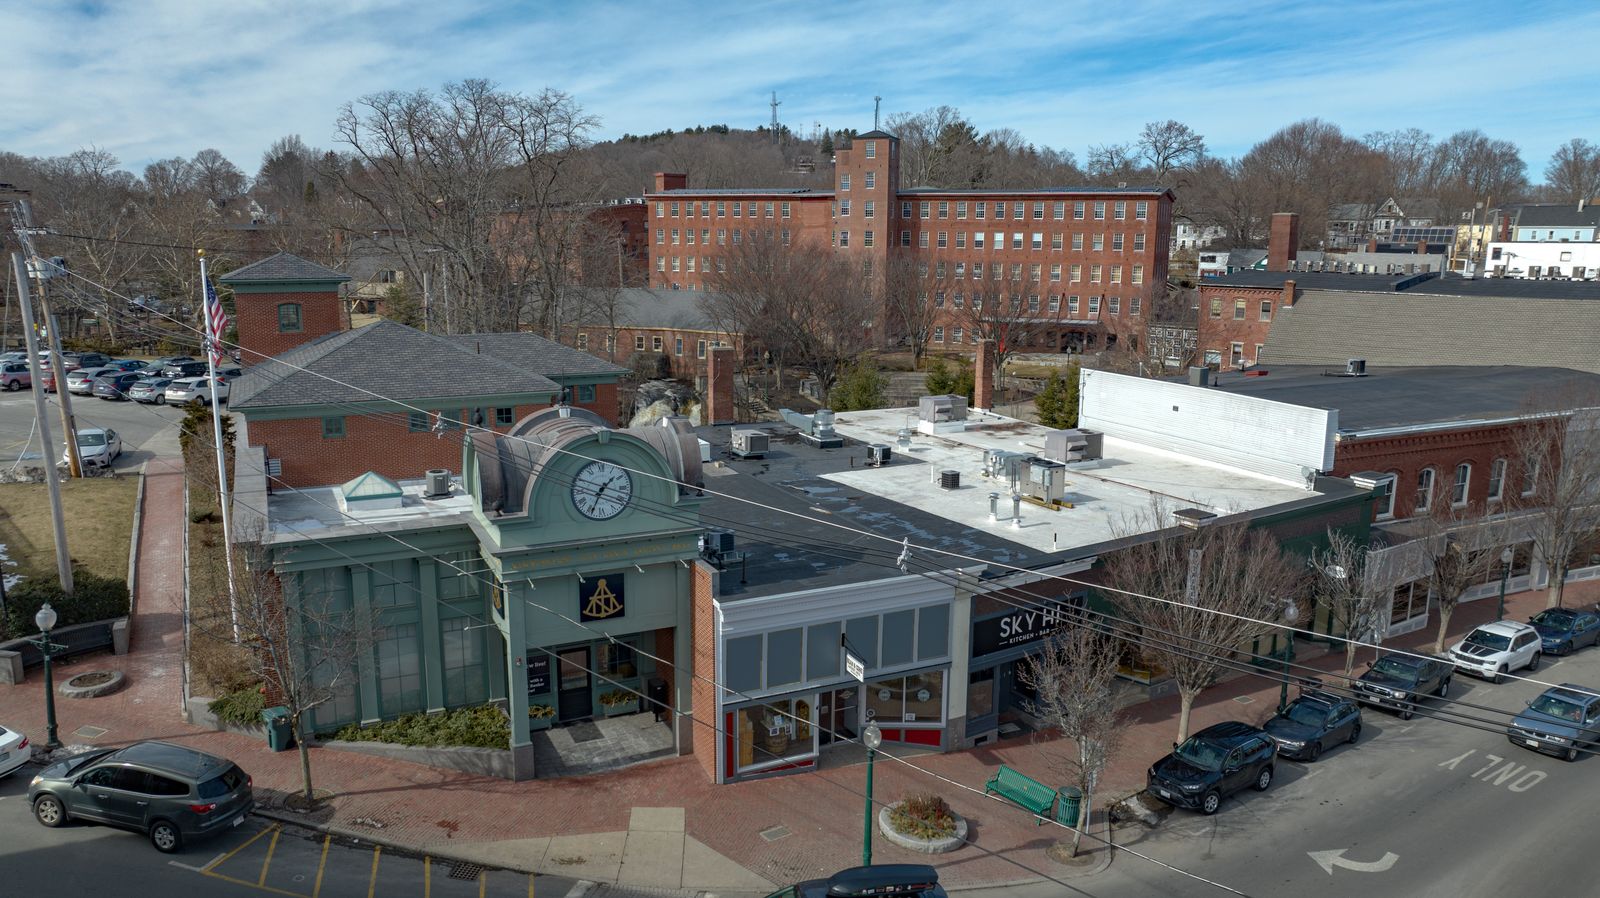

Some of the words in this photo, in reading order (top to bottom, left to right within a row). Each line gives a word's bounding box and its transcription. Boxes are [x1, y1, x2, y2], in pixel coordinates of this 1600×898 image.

[1000, 612, 1037, 637] SKY
[1009, 633, 1034, 644] KITCHEN
[1040, 628, 1050, 636] BAR
[1438, 749, 1548, 793] ONLY
